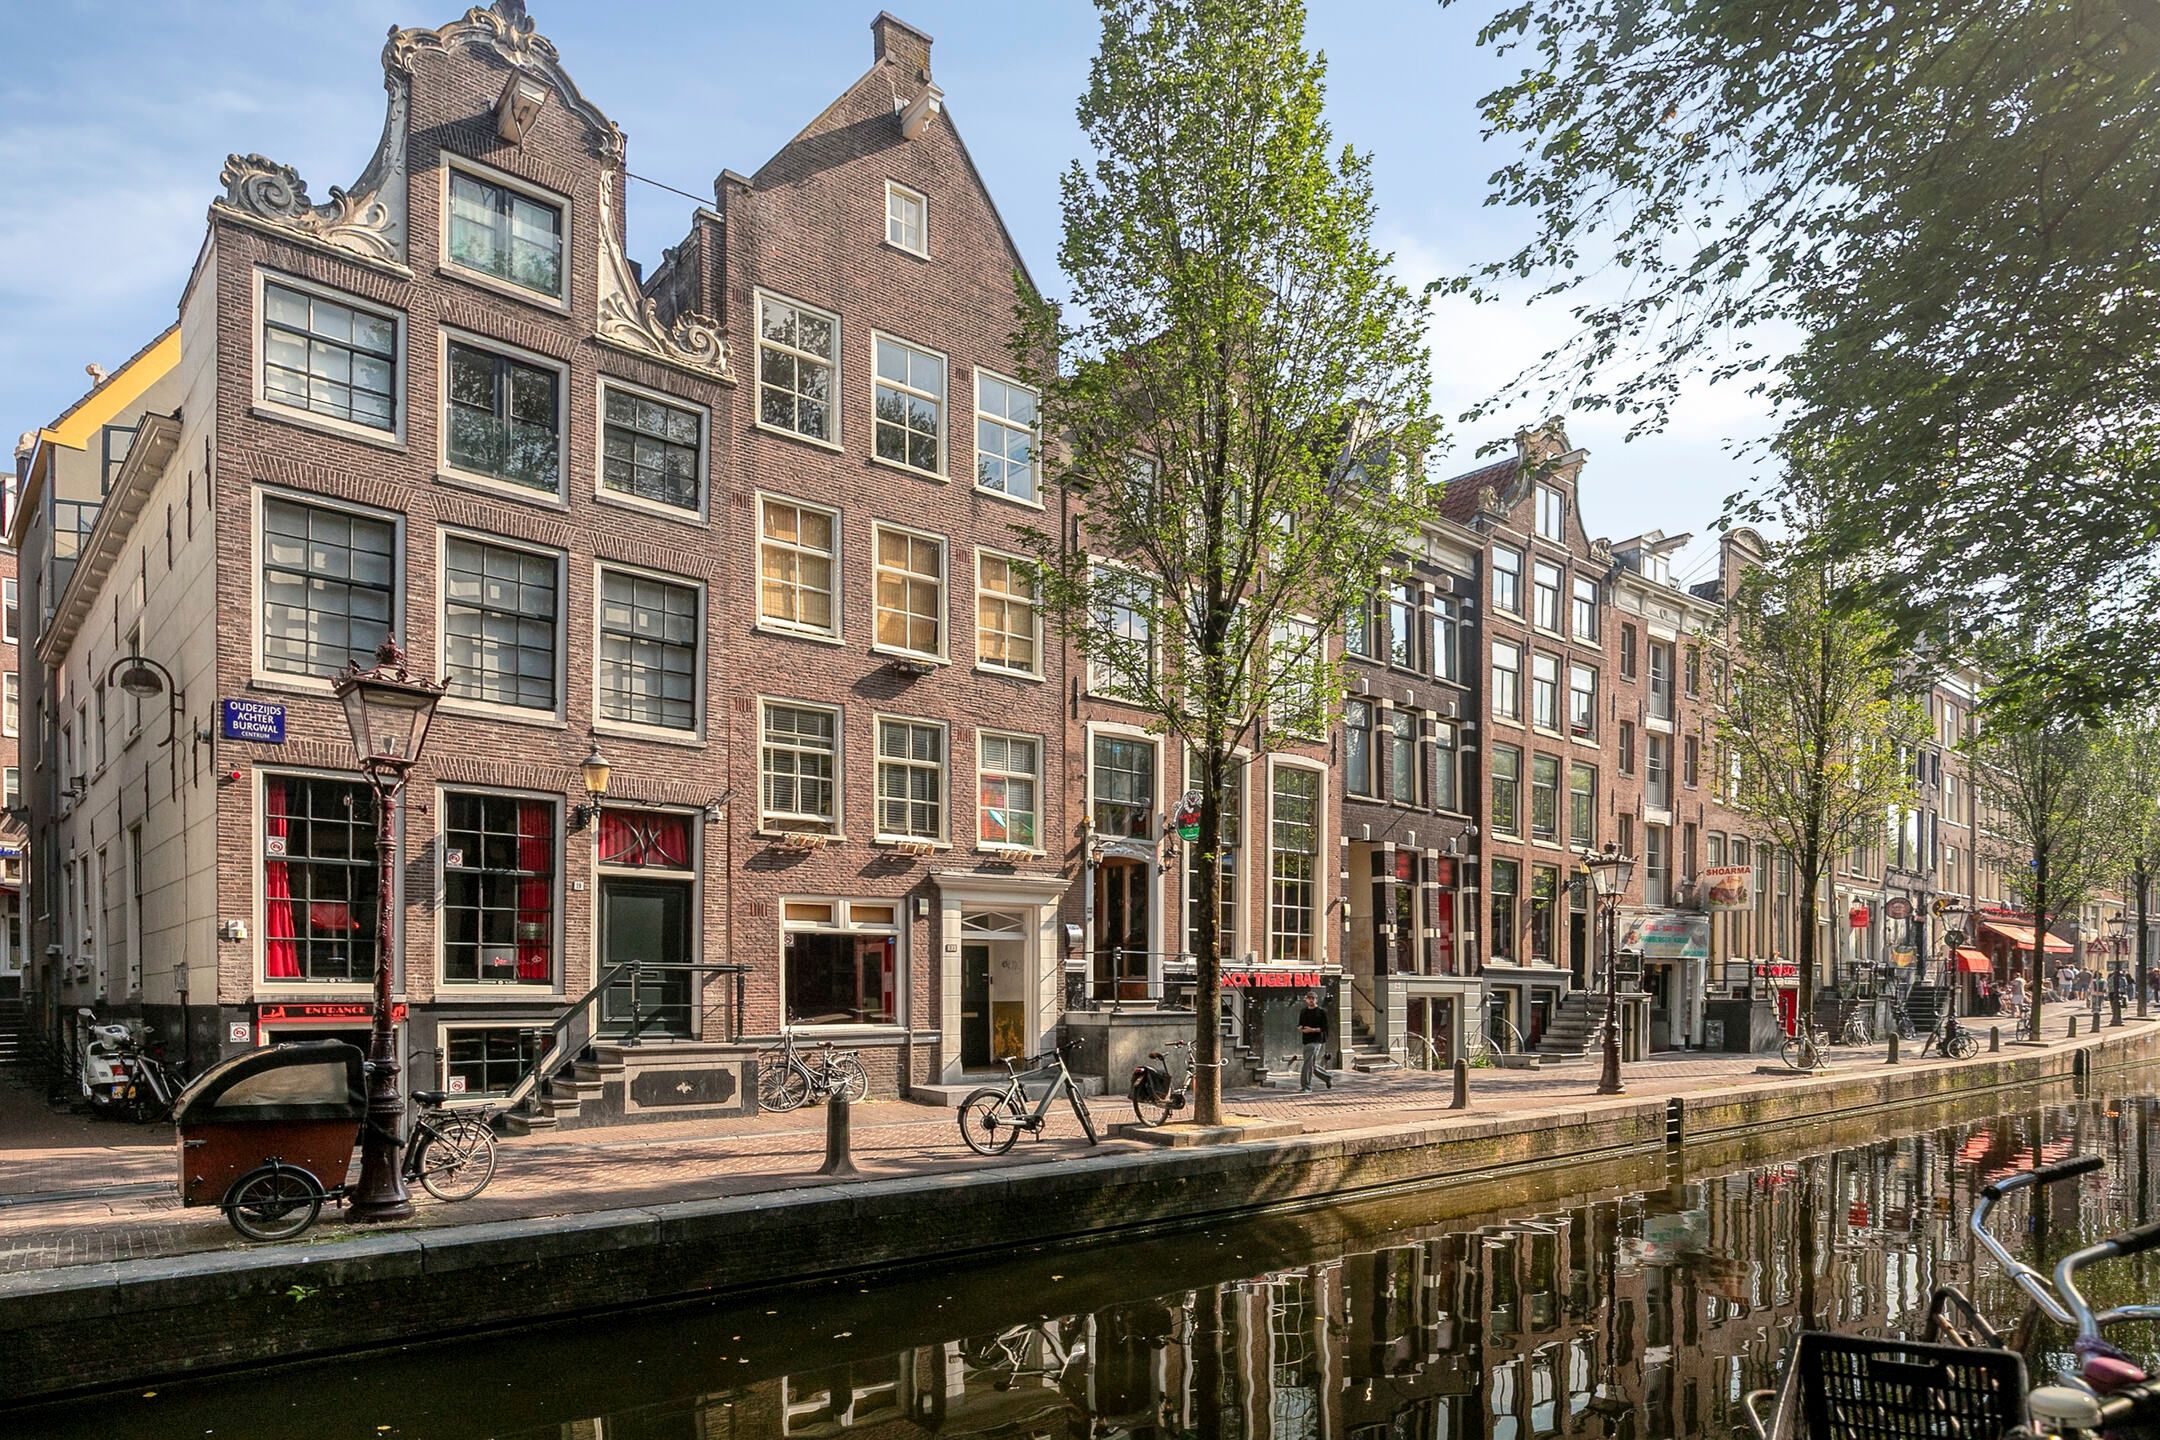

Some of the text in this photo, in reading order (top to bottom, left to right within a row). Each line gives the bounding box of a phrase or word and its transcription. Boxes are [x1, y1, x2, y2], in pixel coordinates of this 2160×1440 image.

[230, 702, 282, 716] OUDEZIJDS
[237, 712, 274, 724] ACHTER
[232, 721, 278, 734] BURGWAL
[241, 731, 270, 739] CENTRUM
[1706, 866, 1751, 876] SHOARMA
[1220, 972, 1321, 987] ACK TIGER BAR
[305, 1006, 366, 1015] ENTRANCE
